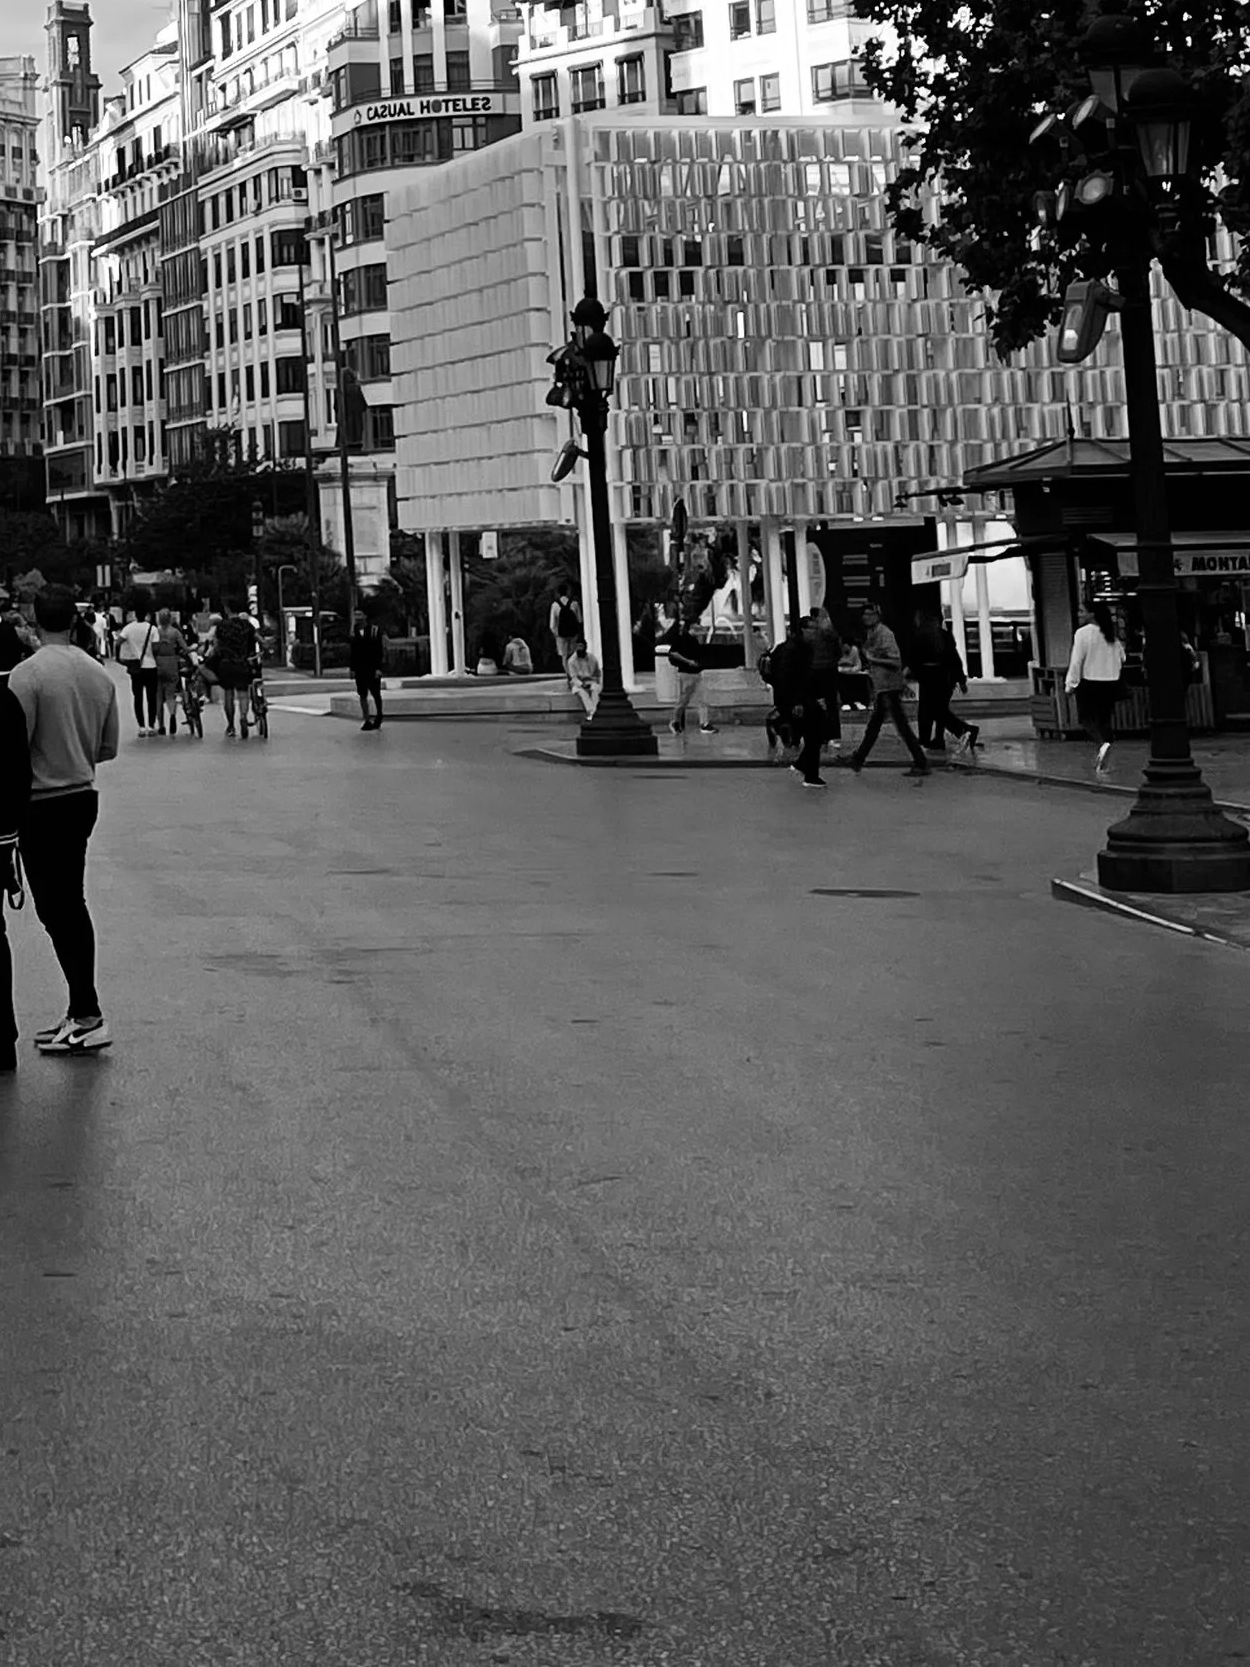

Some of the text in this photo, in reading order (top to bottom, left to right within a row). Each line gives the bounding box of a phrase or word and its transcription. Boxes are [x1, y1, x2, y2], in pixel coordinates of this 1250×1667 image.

[367, 97, 492, 121] CASUAL HOTELES
[1191, 556, 1250, 572] MONTA
